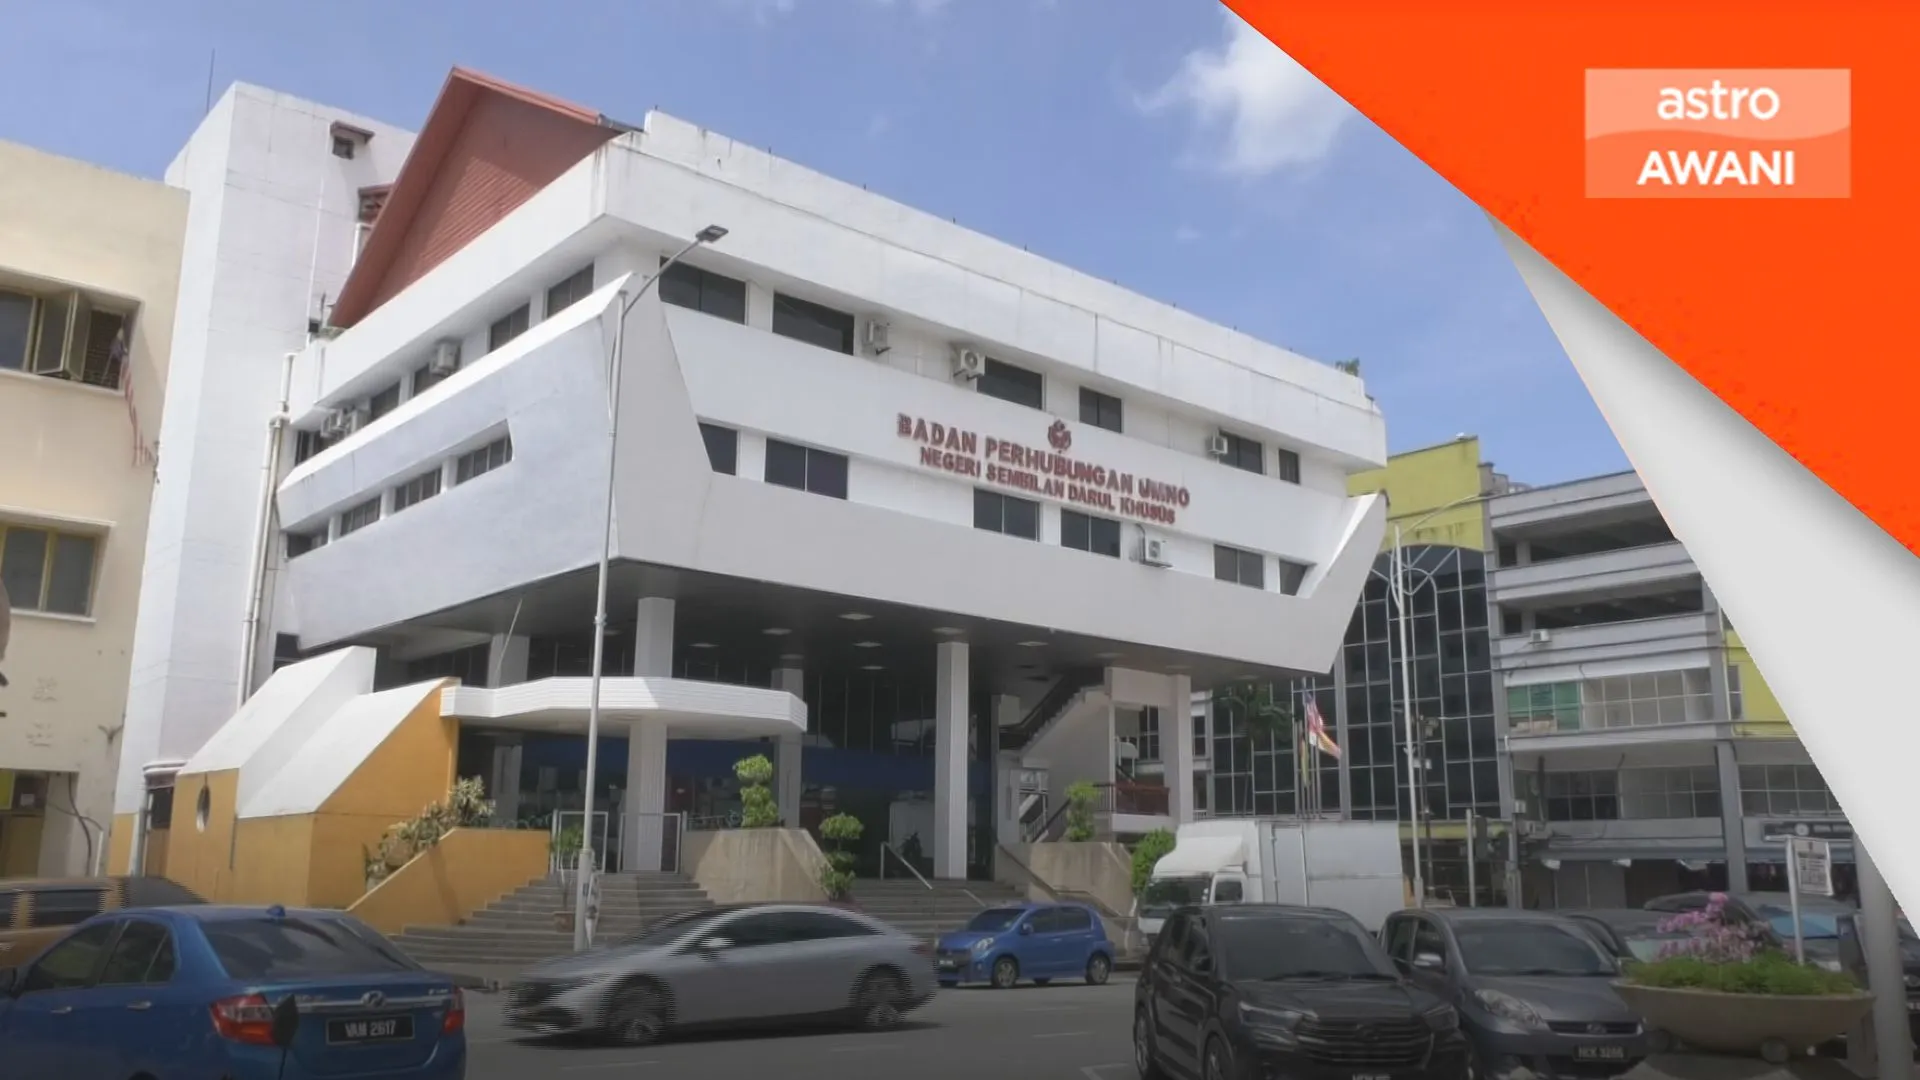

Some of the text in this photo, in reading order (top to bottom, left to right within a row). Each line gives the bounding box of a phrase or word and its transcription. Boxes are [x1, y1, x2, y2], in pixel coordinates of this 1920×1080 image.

[897, 413, 1190, 507] BADAN PERHUBUNGAN UMNO
[920, 446, 1175, 524] NEGERI SEMBILAN DARUL KHUSUS
